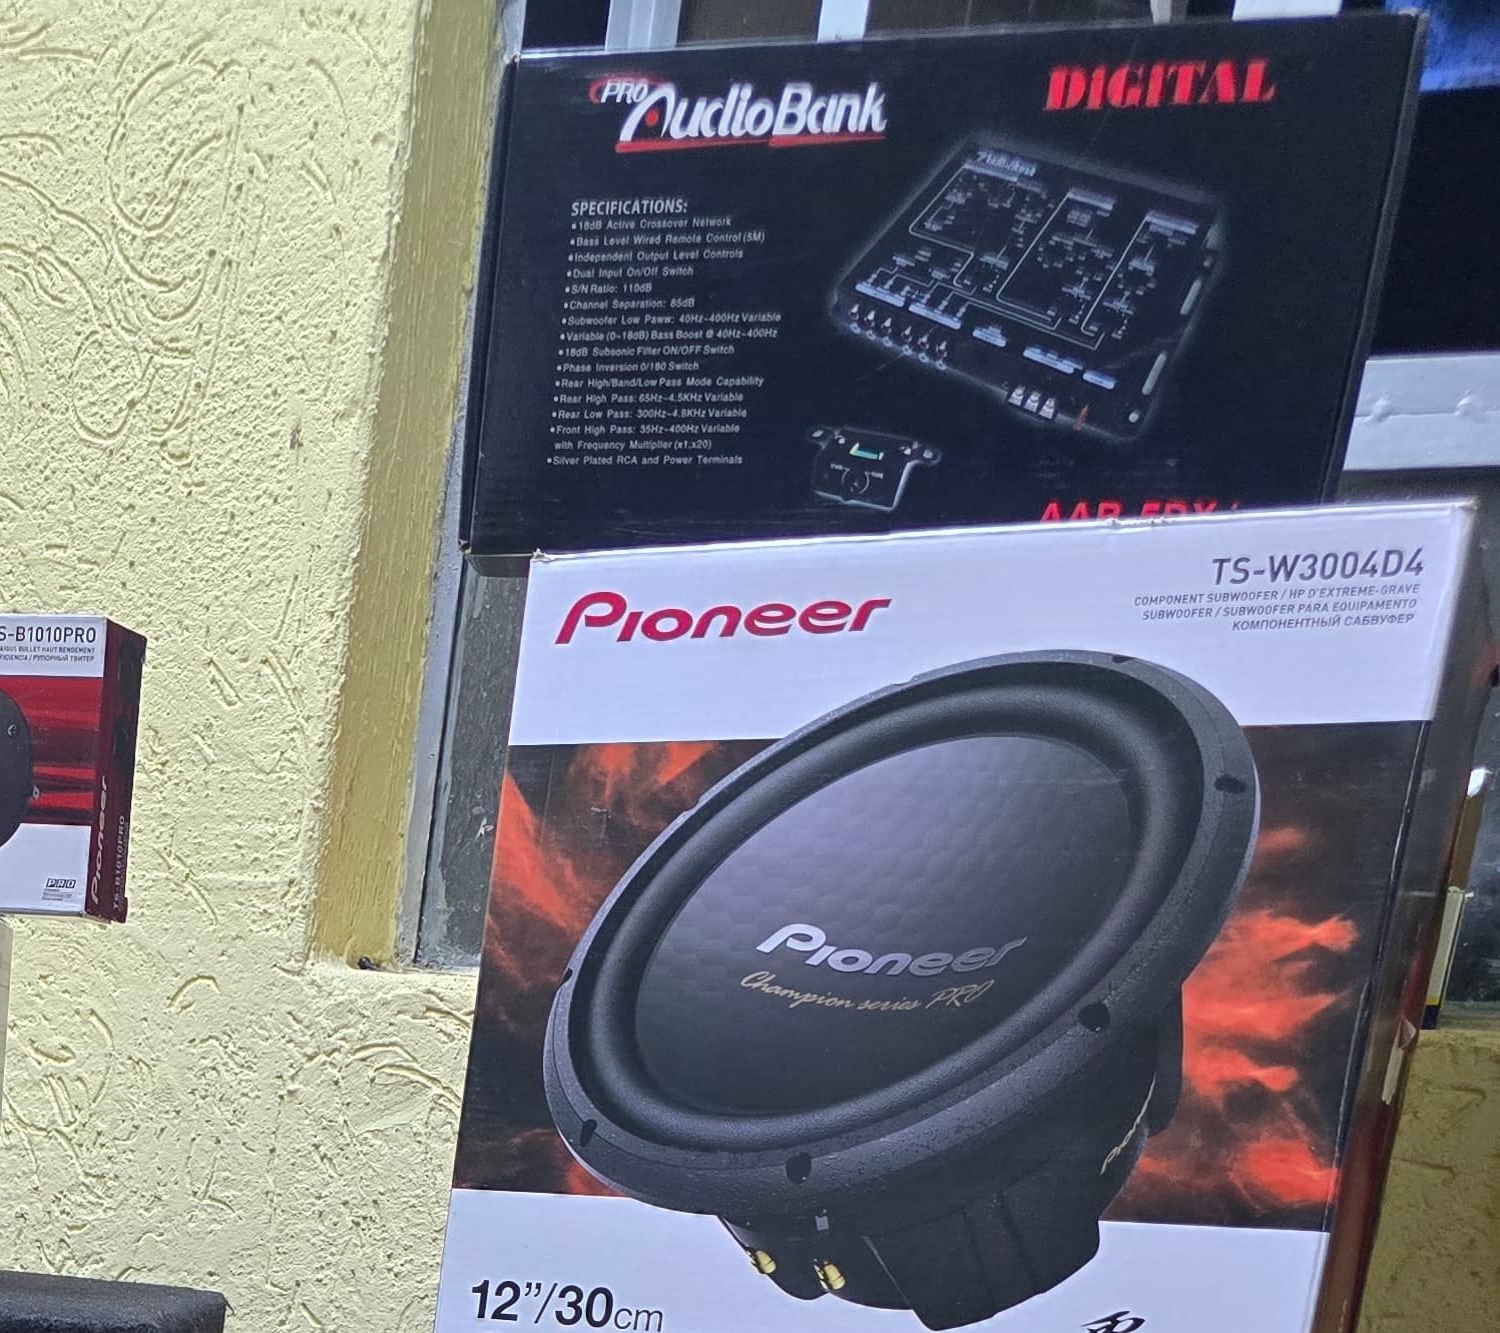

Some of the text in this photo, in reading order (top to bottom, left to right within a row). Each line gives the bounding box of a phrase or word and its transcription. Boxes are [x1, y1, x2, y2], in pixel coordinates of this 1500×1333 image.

[1043, 58, 1277, 111] DIGITAL
[600, 79, 887, 142] PRO AudioBank
[571, 199, 688, 217] SPECIFICATIONS:
[692, 216, 732, 227] Network
[633, 234, 661, 245] Wired
[575, 249, 744, 263] Independent Output Level Controls
[599, 268, 622, 279] Input
[662, 266, 693, 276] Switch
[570, 299, 607, 310] Channel
[704, 345, 735, 354] Switch
[563, 361, 699, 373] Phase Inversion Switch
[561, 378, 583, 388] Rear
[687, 377, 712, 386] Mode
[560, 394, 581, 404] Rear
[586, 394, 607, 405] High
[558, 410, 580, 419] Rear
[556, 425, 580, 434] Front
[584, 425, 605, 436] High
[577, 440, 625, 452] Frequency
[553, 454, 743, 465] Silver Plated RCA and Power Terminals
[1212, 547, 1424, 586] TS-W3004D4
[1134, 584, 1420, 606] COMPONENT SUBWOOFER HP D'EXTREME-GRAVE
[1142, 599, 1418, 620] SUBWOOFER SUBWOOFER PARA EQUIPAMENTO
[555, 591, 892, 644] Pioneer
[1232, 614, 1414, 631] КОМПОНЕНТНЫЙ САБВУФЕР
[91, 775, 107, 905] Pioneer
[756, 923, 1028, 976] Pioneer
[740, 971, 995, 1011] Champion series PRO
